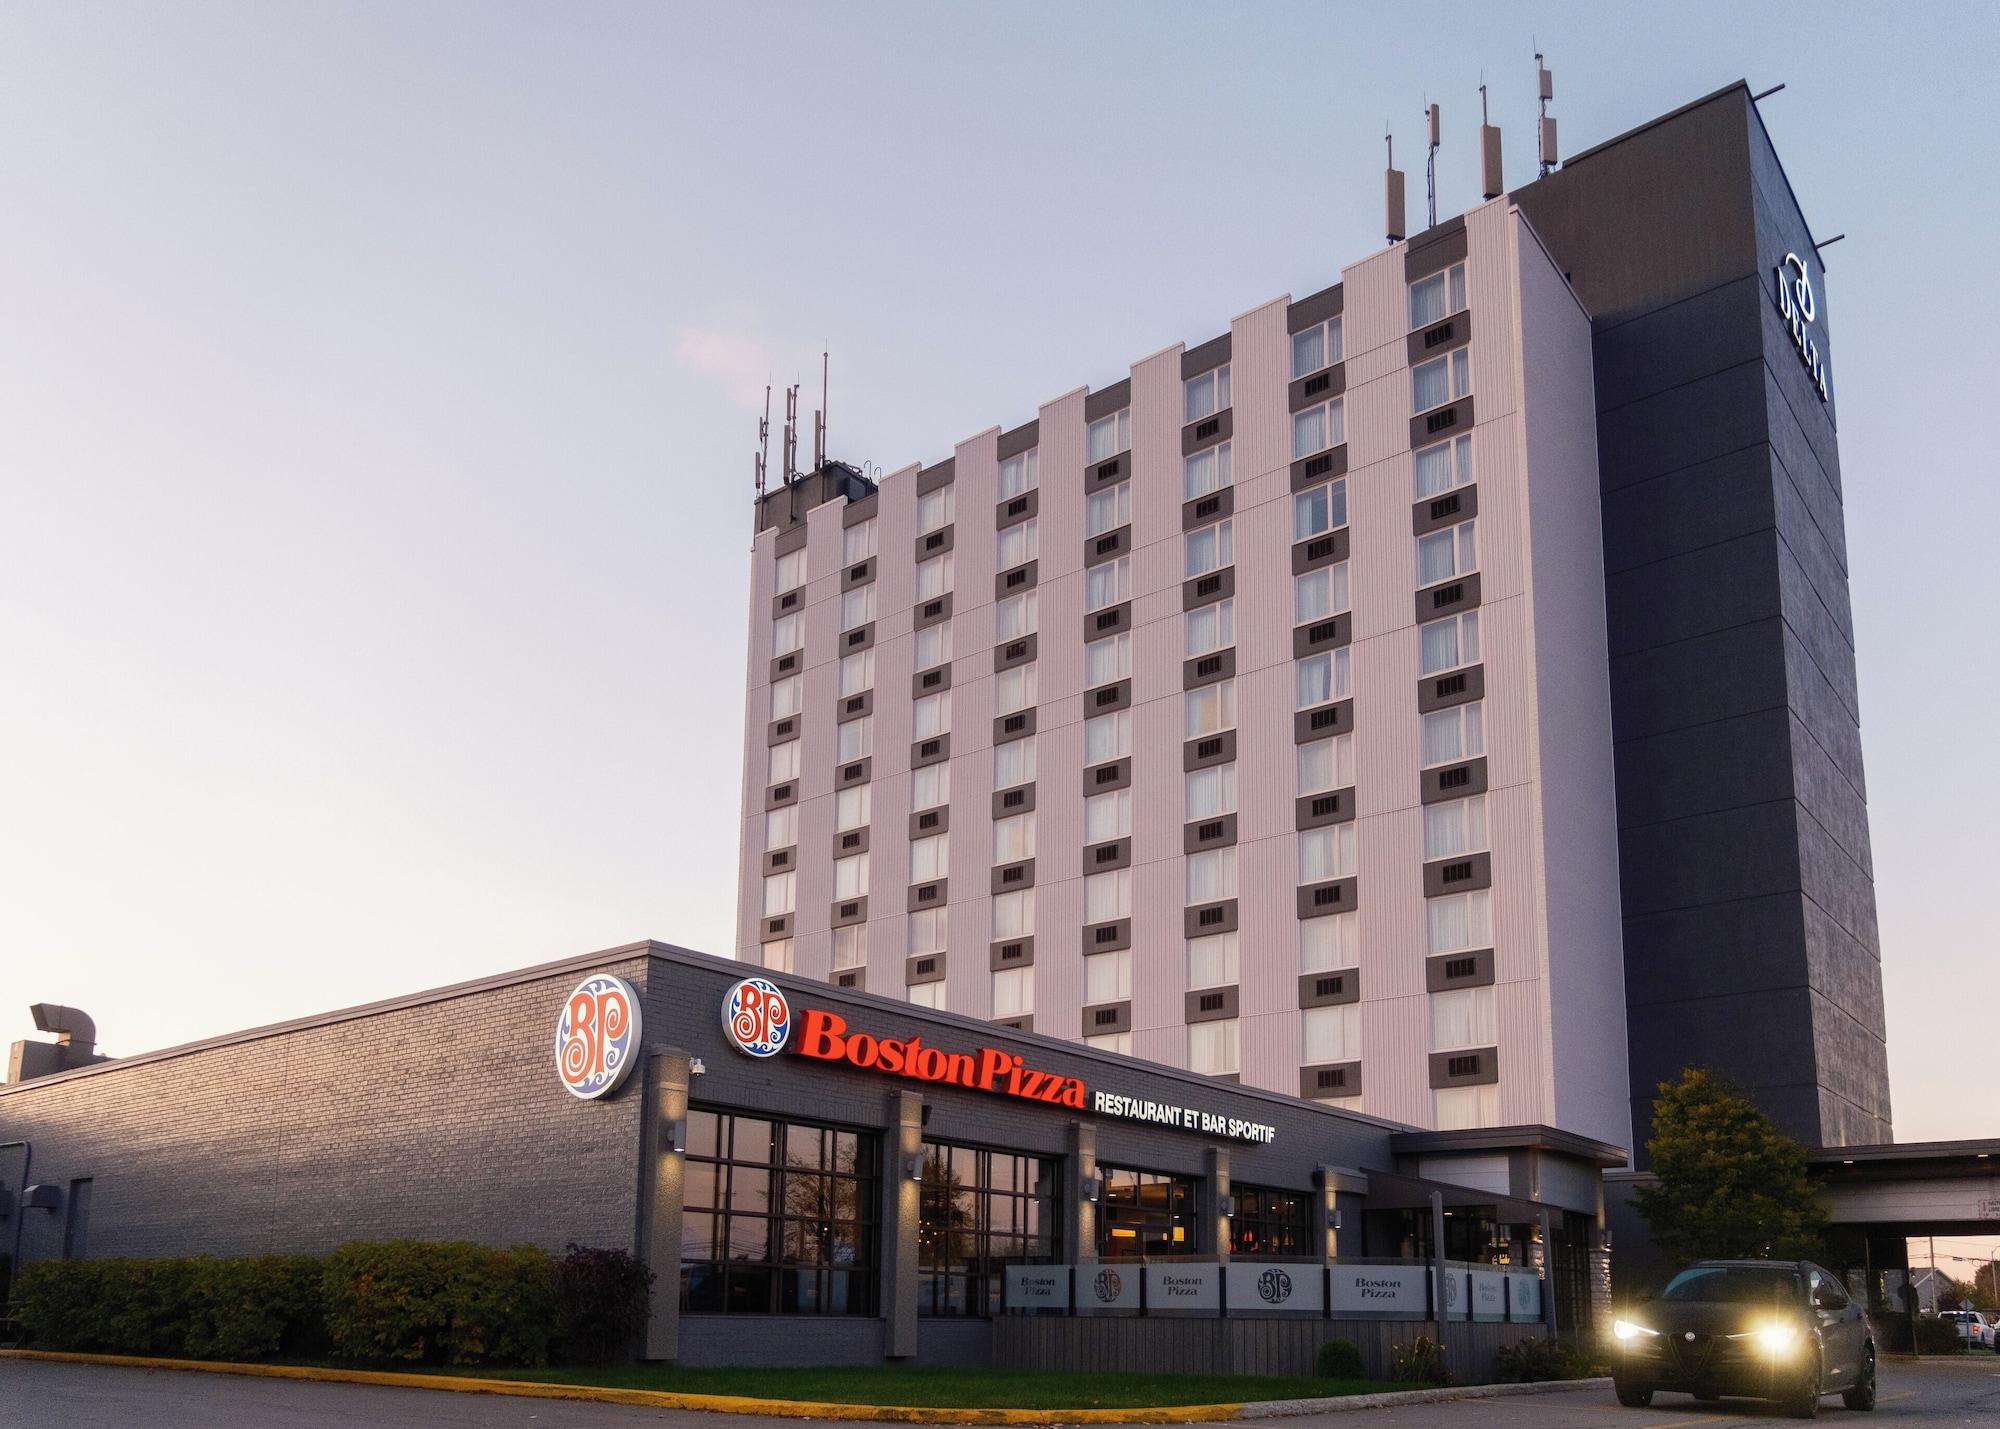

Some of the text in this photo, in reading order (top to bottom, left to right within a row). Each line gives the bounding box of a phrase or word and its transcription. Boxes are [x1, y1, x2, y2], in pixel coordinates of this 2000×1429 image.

[1778, 266, 1828, 401] DELTA
[799, 1009, 1087, 1109] Boston Pizza
[1094, 1091, 1275, 1144] RESTAURANT ET BAR SPORTIF
[1162, 1276, 1202, 1286] Boston
[1355, 1277, 1401, 1288] Boston
[1168, 1287, 1198, 1296] Pizza
[1361, 1288, 1396, 1298] Pizza
